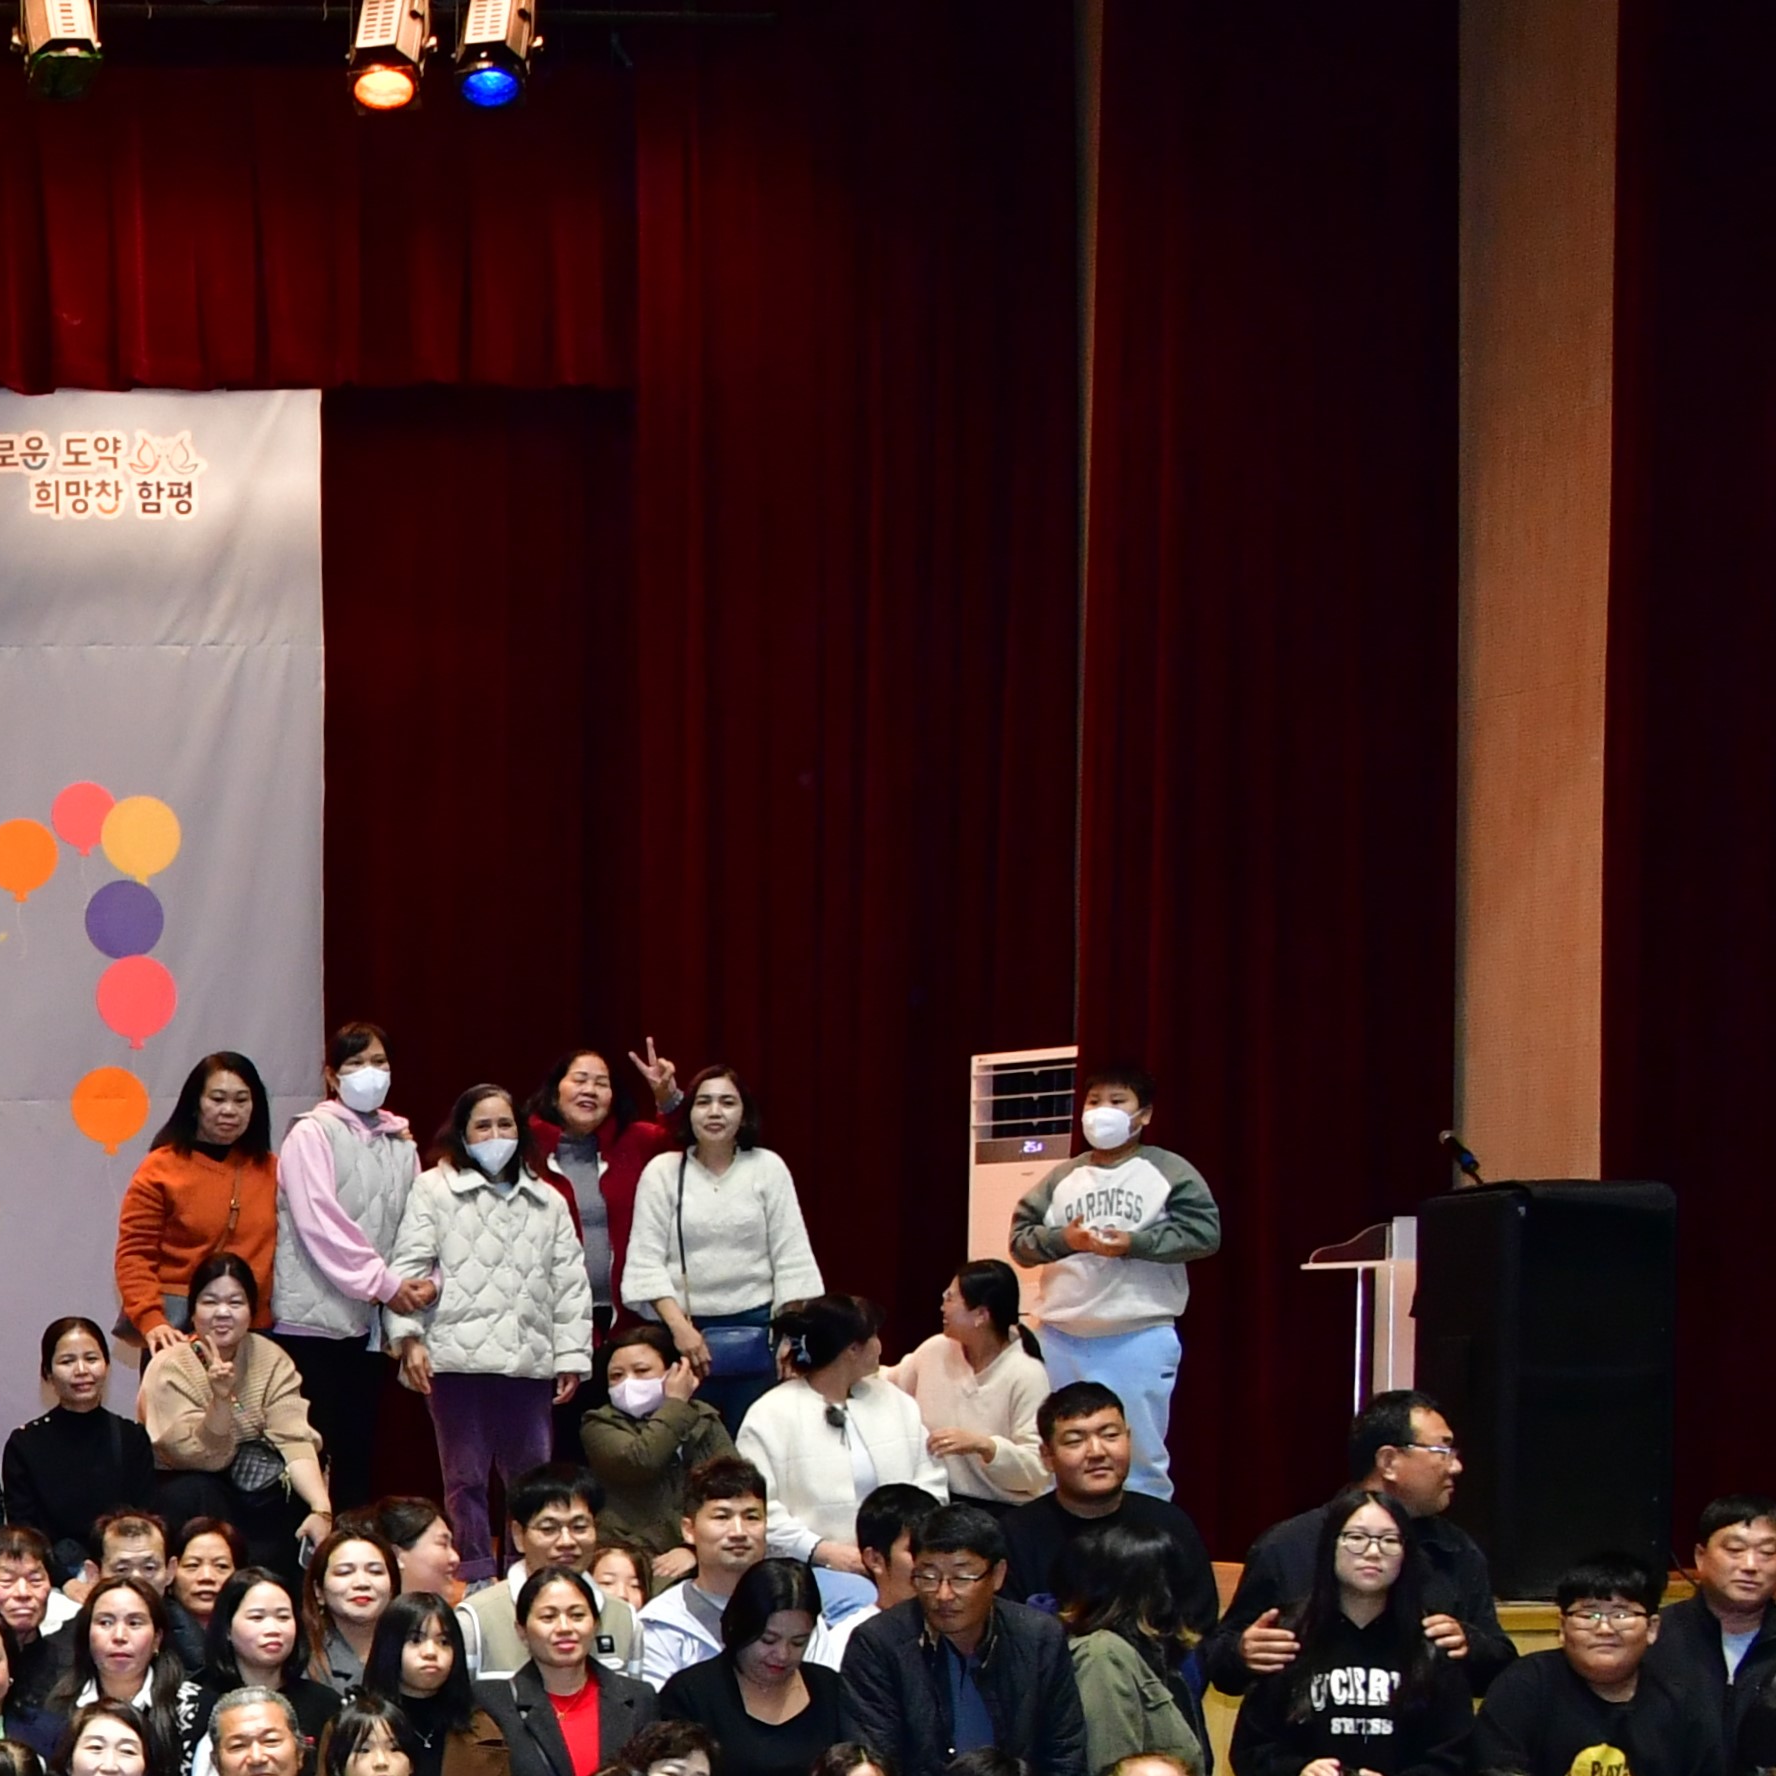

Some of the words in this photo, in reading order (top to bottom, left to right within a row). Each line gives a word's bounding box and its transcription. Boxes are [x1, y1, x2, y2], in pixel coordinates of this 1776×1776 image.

[62, 436, 122, 469] 도약
[35, 479, 124, 515] 희망찬
[136, 480, 194, 515] 함평
